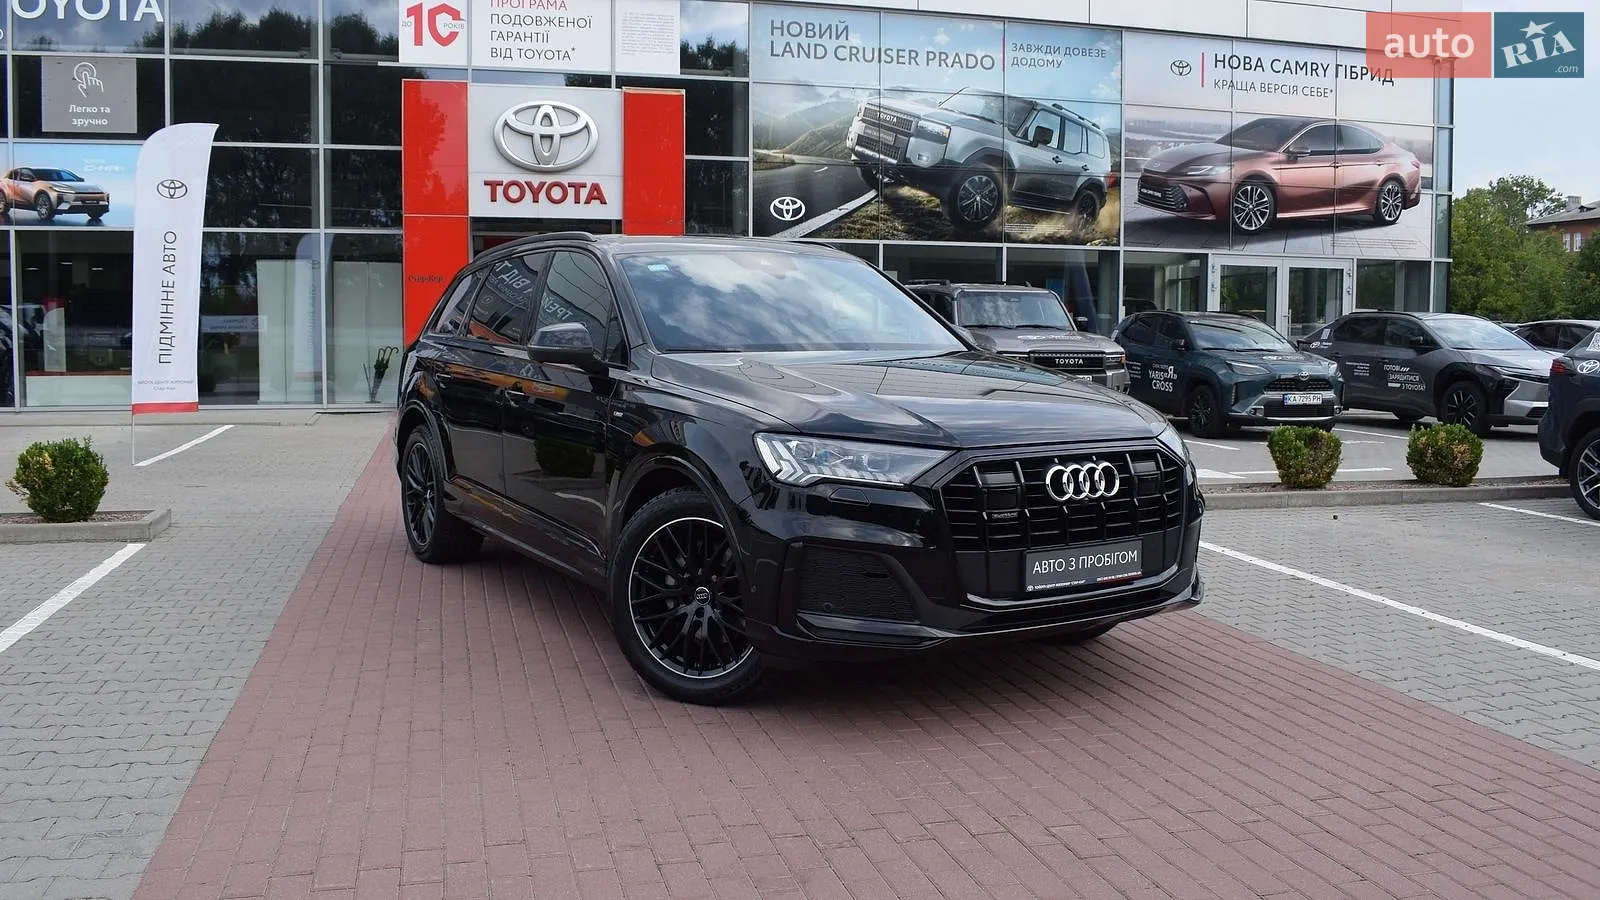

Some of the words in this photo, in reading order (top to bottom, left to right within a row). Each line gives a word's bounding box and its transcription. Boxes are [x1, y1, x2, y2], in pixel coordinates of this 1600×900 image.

[12, 0, 164, 22] OYOTA
[490, 0, 568, 11] ПРОГРАМА
[490, 13, 593, 29] ПОДОВЖЕНОЇ
[490, 30, 550, 43] ГАРАНТІЇ
[770, 19, 850, 42] НОВИЙ
[490, 47, 514, 61] ВІД
[770, 41, 828, 60] LAND
[833, 44, 919, 65] CRUISER
[925, 52, 996, 71] PRADO
[1010, 42, 1061, 56] ЗАВЖДИ
[1063, 46, 1107, 59] ДОВЕЗЕ
[1010, 58, 1063, 69] ДОДОМУ
[1214, 53, 1266, 74] НОВА
[1270, 58, 1330, 79] CAMRY
[1334, 64, 1395, 86] ГІБРИД
[1214, 79, 1257, 94] КРАЩА
[1259, 82, 1299, 96] ВЕРСІЯ
[68, 104, 98, 113] Легко
[71, 118, 109, 127] зручно
[483, 180, 608, 206] TOYOTA
[162, 230, 178, 275] АВТО
[158, 280, 176, 365] ПІДМІННЕ
[1149, 370, 1165, 381] YARIS
[1152, 379, 1174, 392] CROSS
[1032, 557, 1067, 575] АВТО
[1068, 556, 1075, 571] З
[1079, 549, 1138, 570] ПРОБІГОМ
